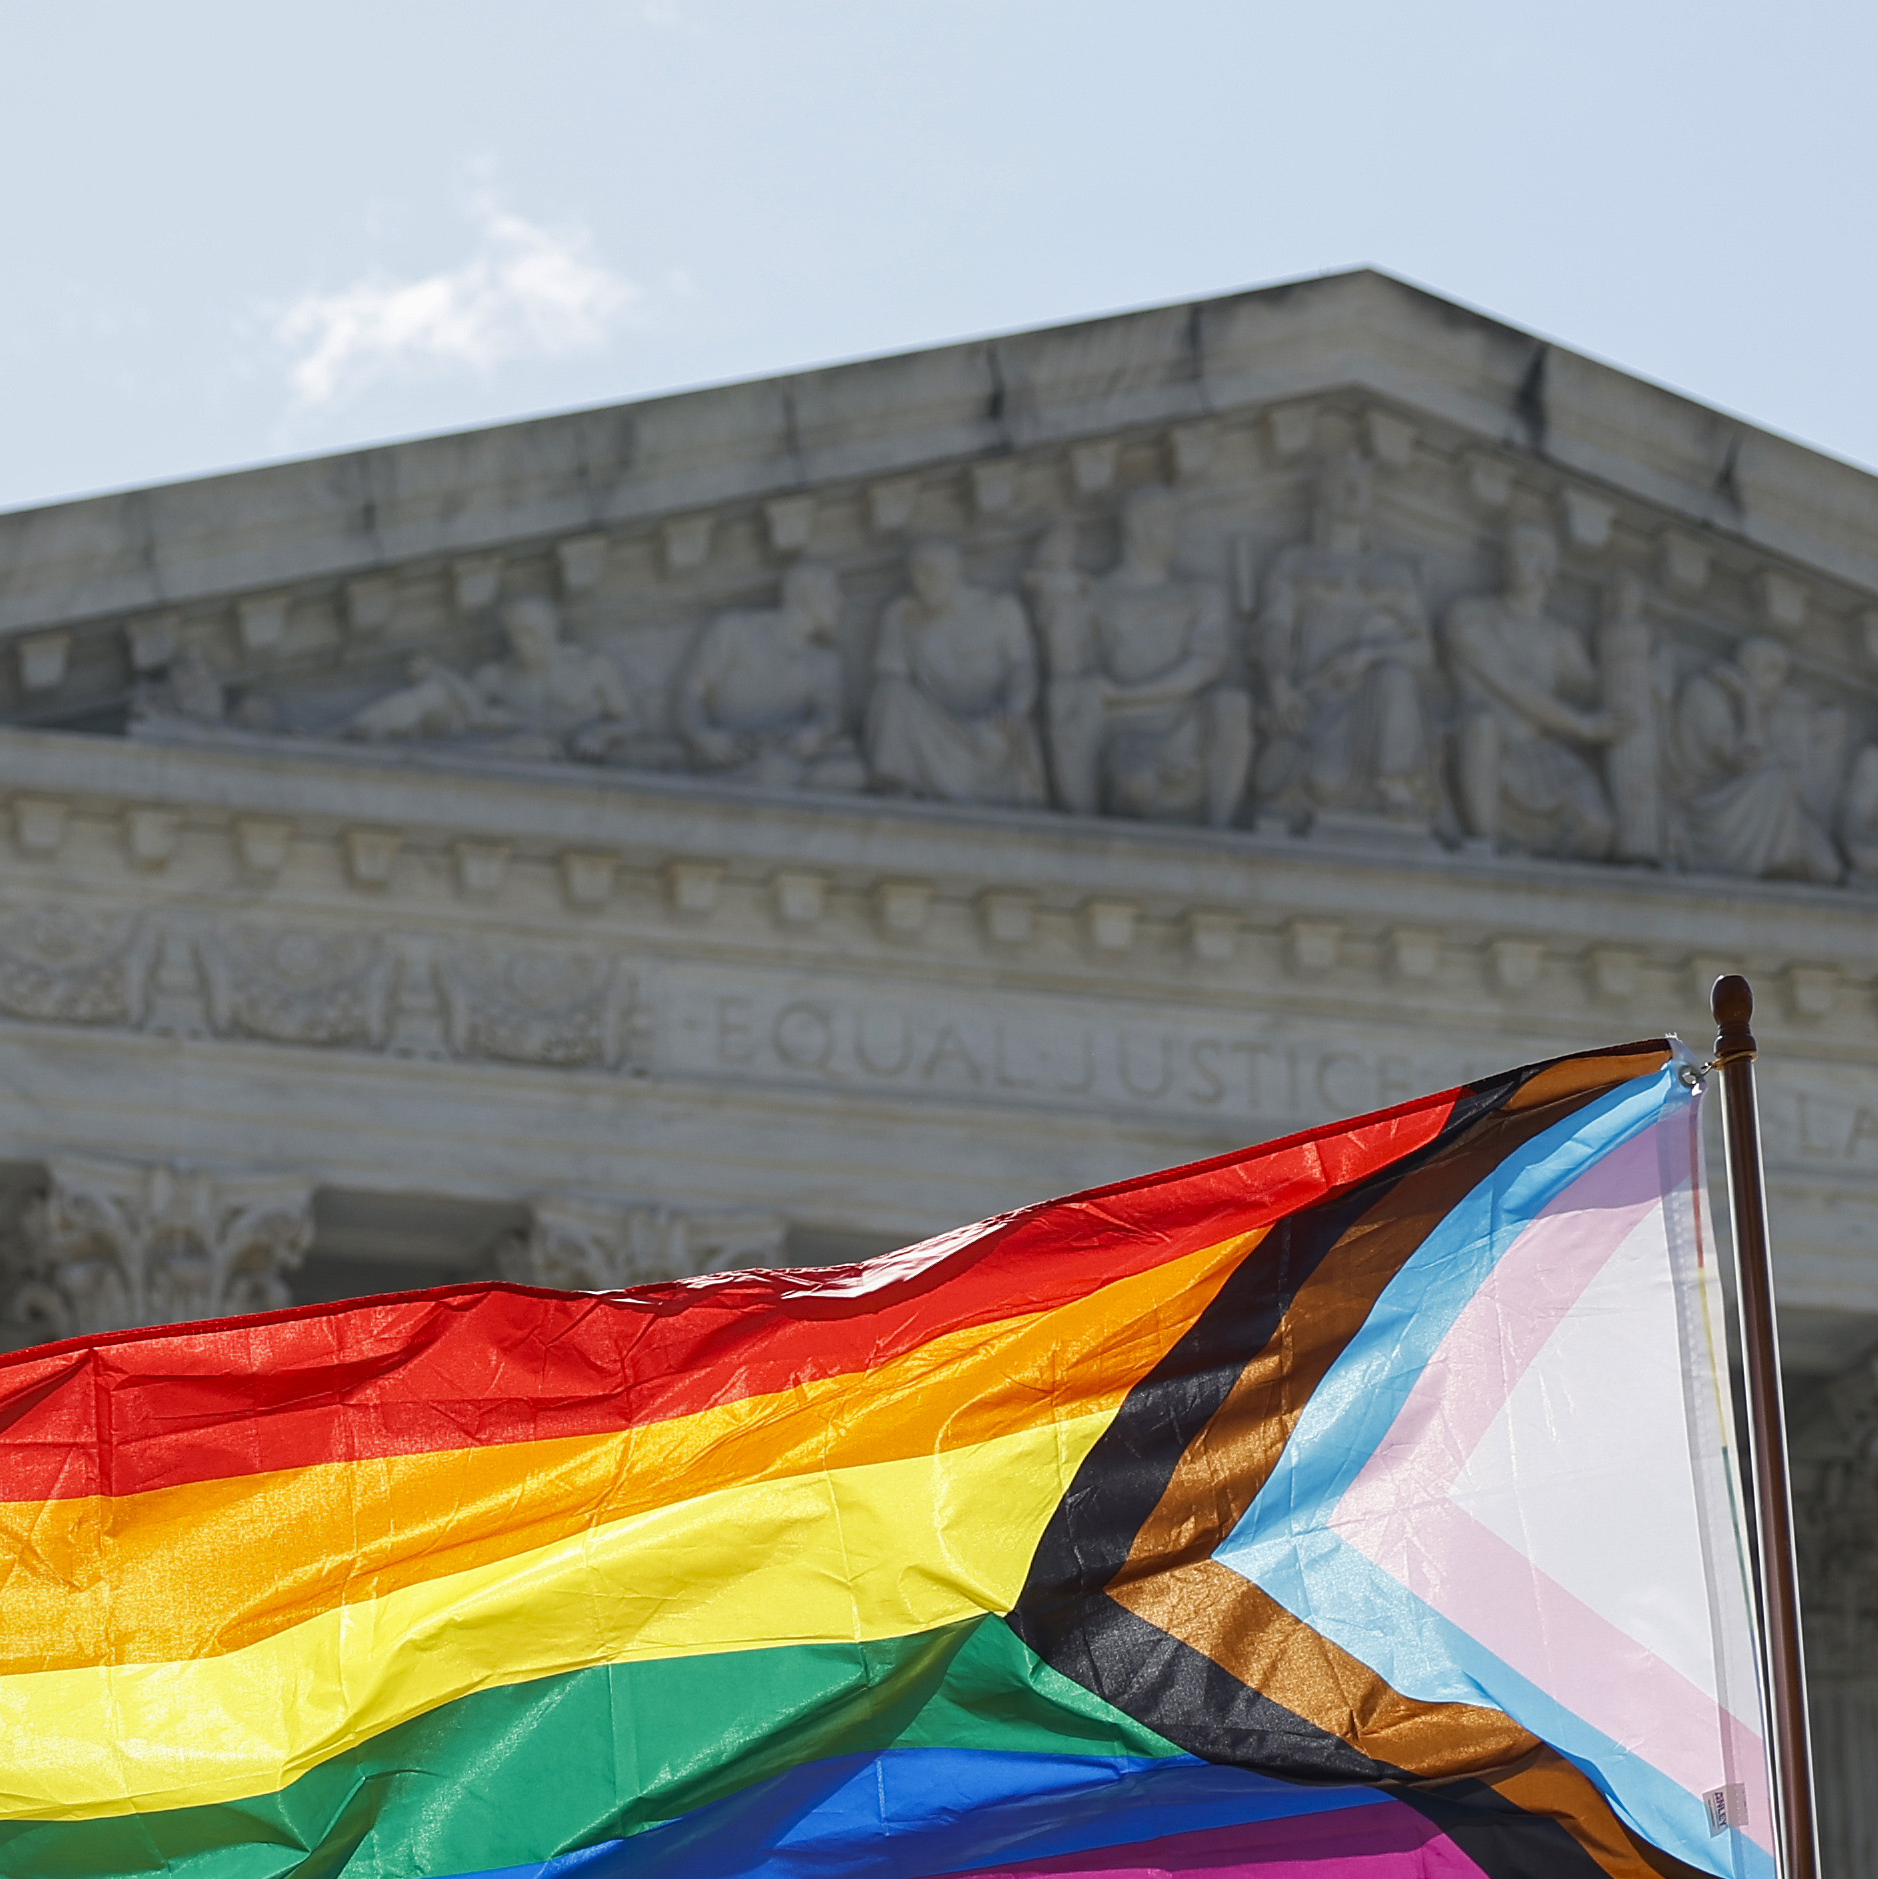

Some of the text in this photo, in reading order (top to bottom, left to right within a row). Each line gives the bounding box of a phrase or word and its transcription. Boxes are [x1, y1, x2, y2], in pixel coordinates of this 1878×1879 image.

[715, 994, 1035, 1089] EQUAL
[1055, 1028, 1414, 1118] JUSTICE
[1714, 1791, 1727, 1826] ANLEY
